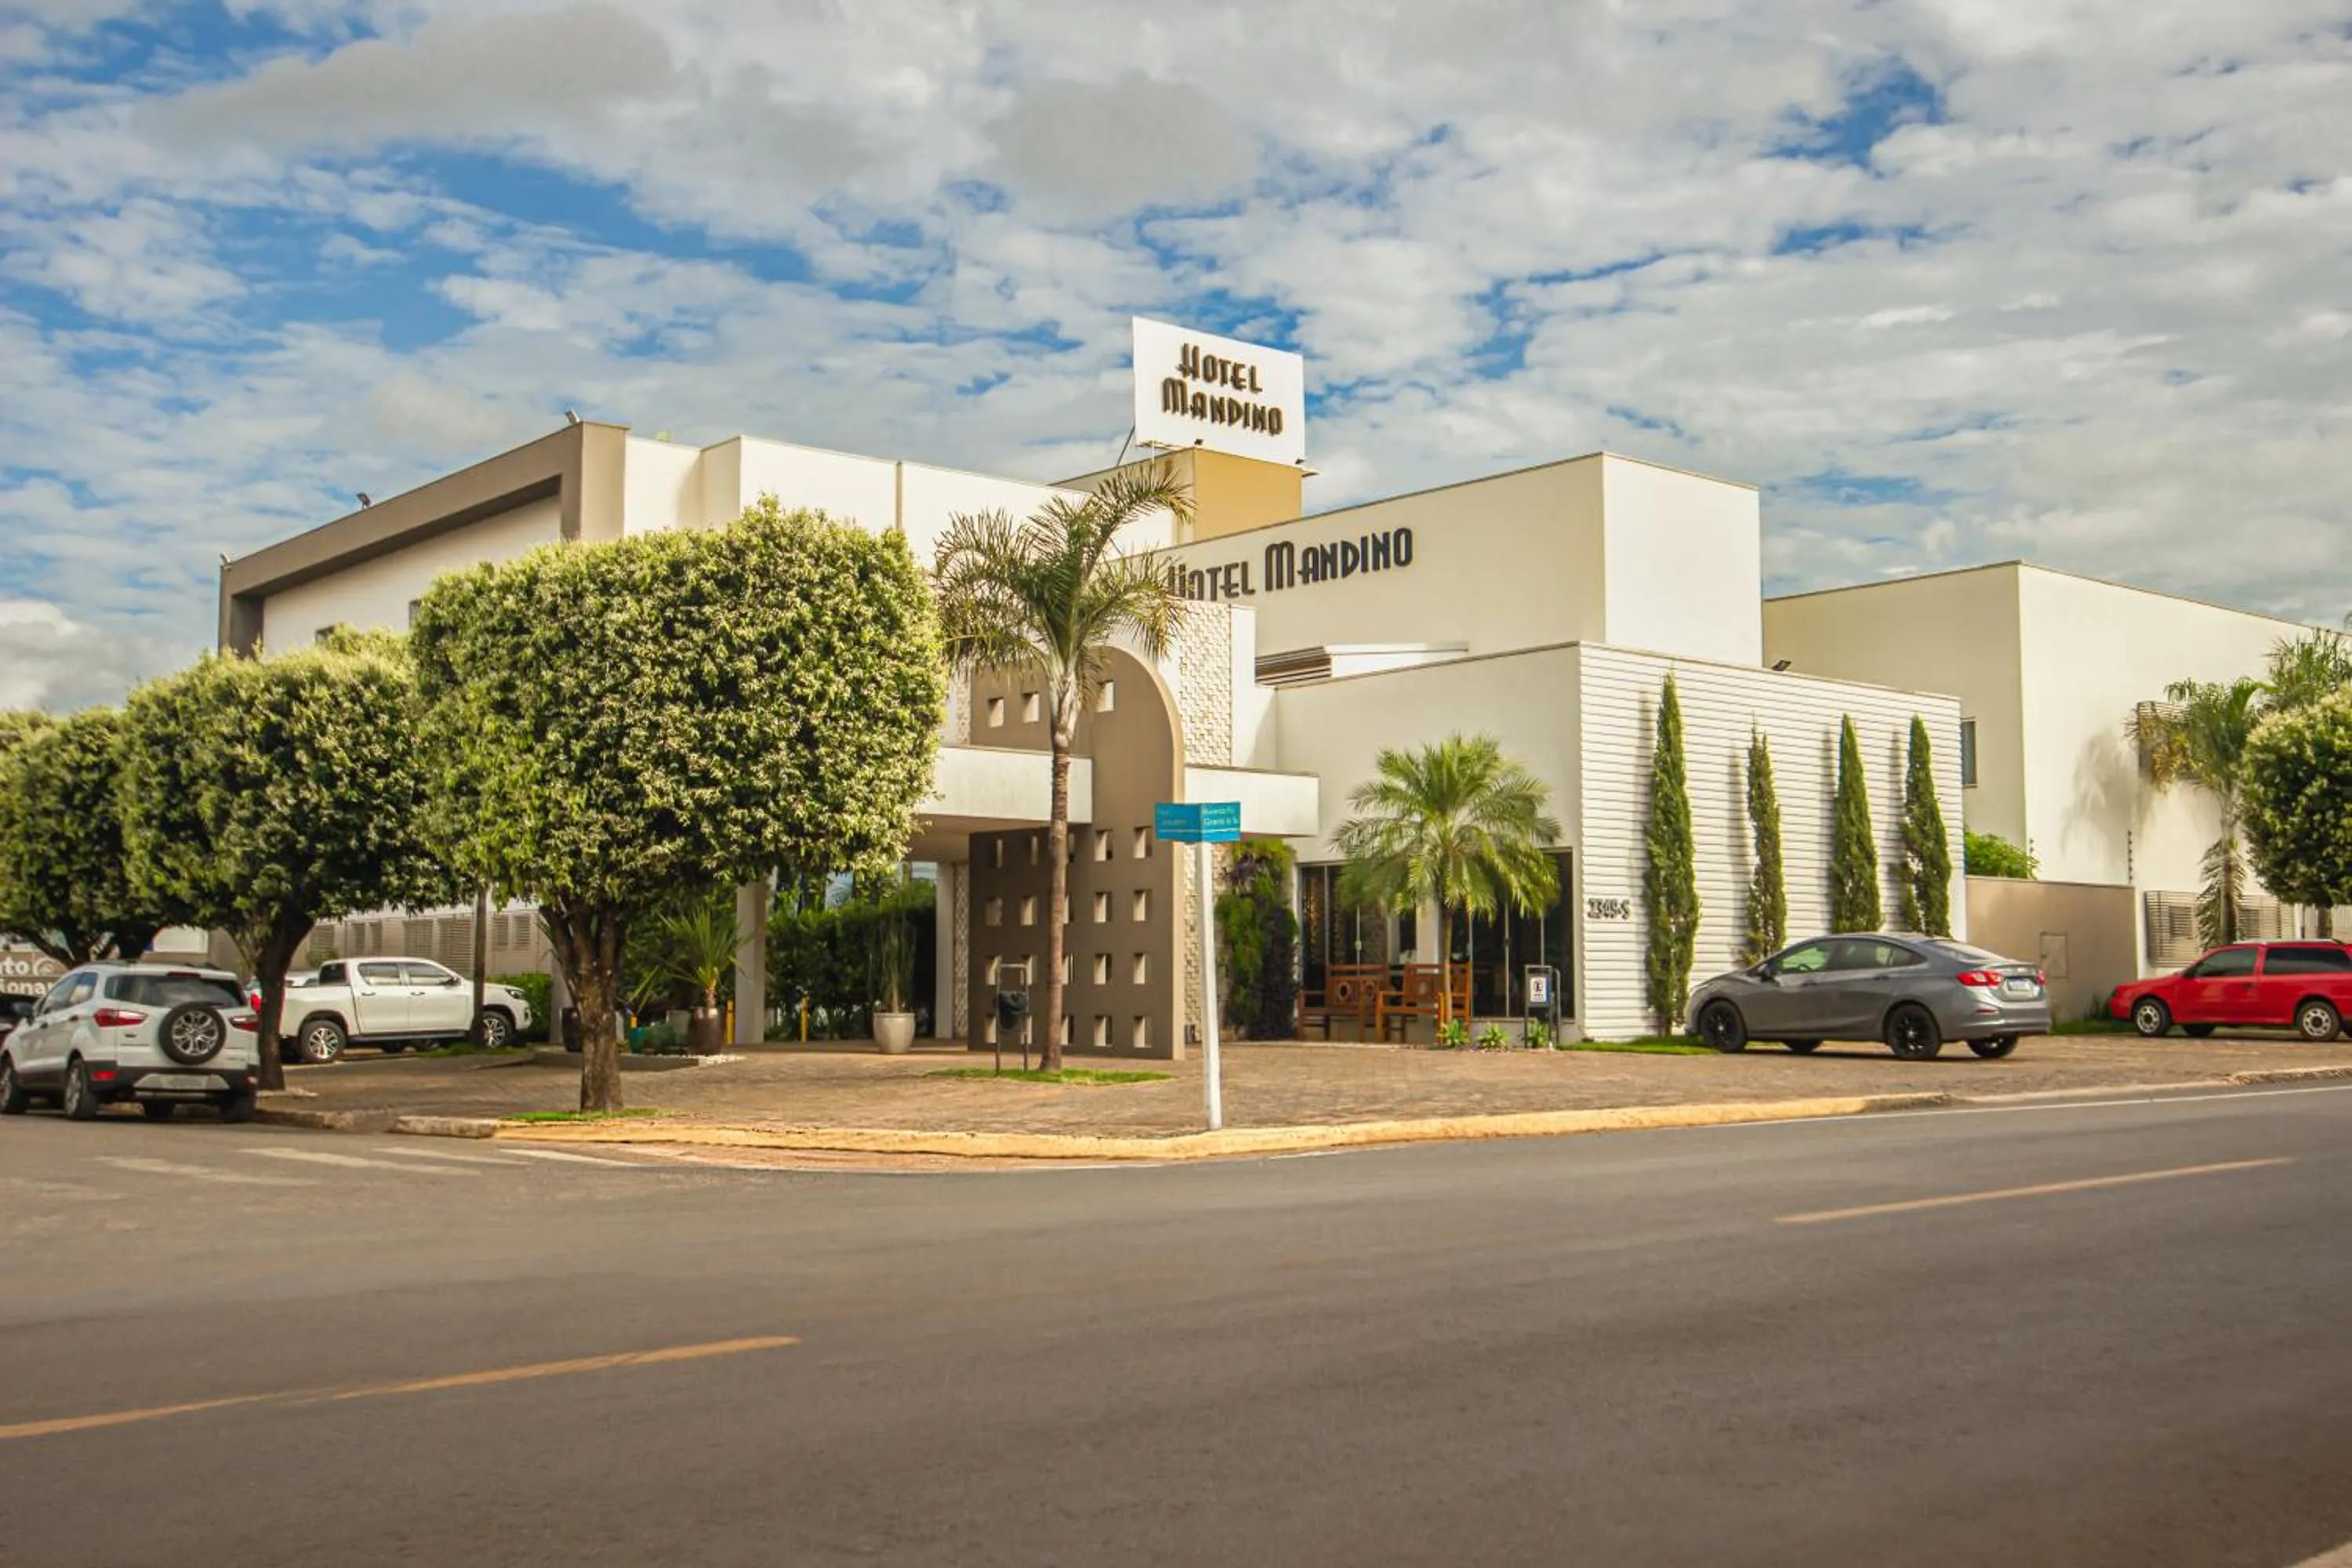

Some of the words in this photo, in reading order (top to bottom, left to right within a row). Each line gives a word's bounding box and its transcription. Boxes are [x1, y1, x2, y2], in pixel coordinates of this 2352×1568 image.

[1176, 342, 1263, 394] HOTEL
[1162, 377, 1283, 436] MANDINO
[1265, 527, 1414, 592] MANDINO
